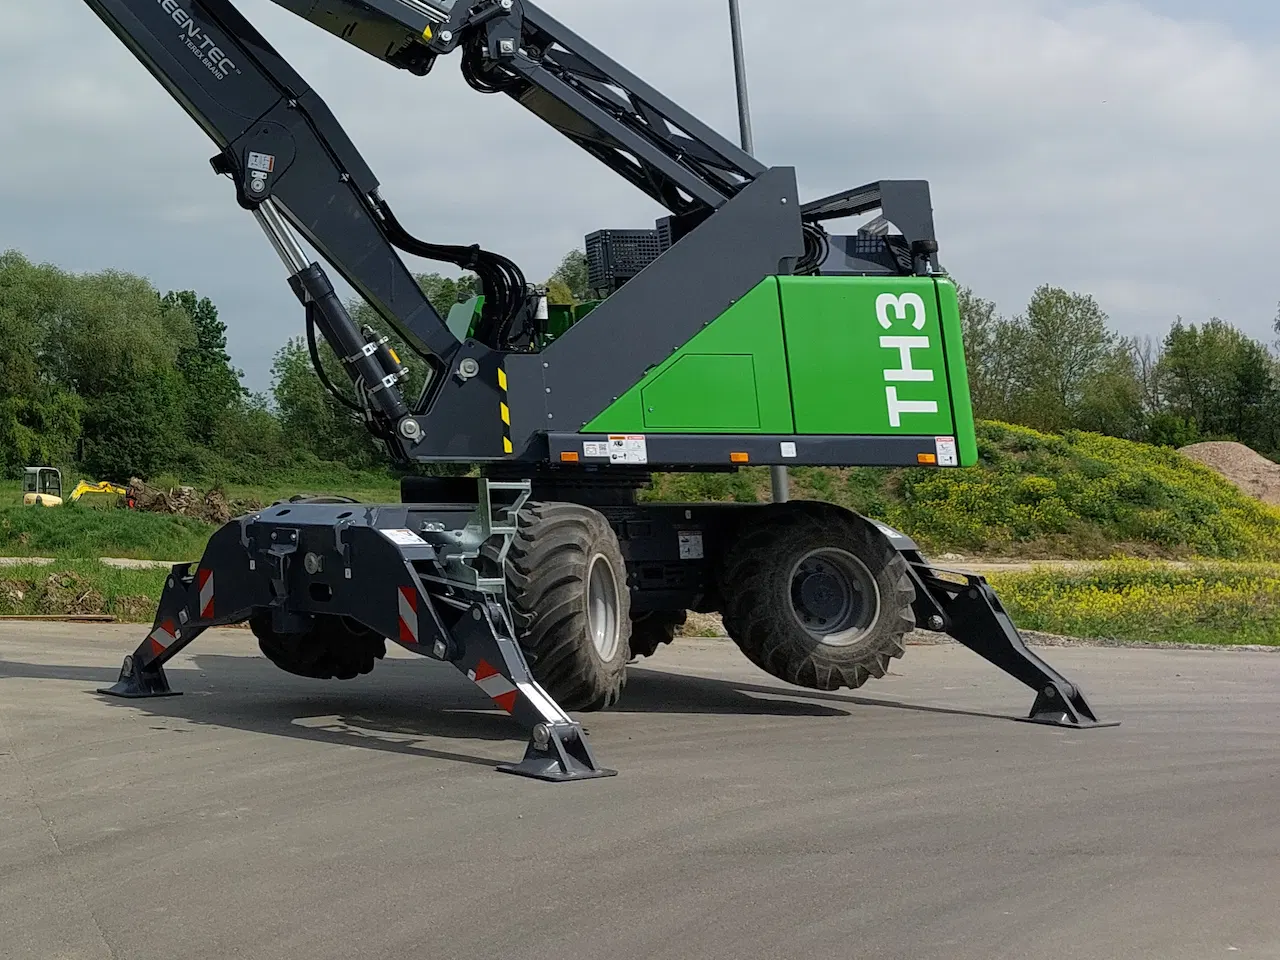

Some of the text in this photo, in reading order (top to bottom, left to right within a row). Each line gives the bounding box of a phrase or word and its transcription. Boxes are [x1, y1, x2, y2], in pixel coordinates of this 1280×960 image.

[178, 33, 224, 80] A TEREX BRAND
[875, 292, 938, 427] TH3
